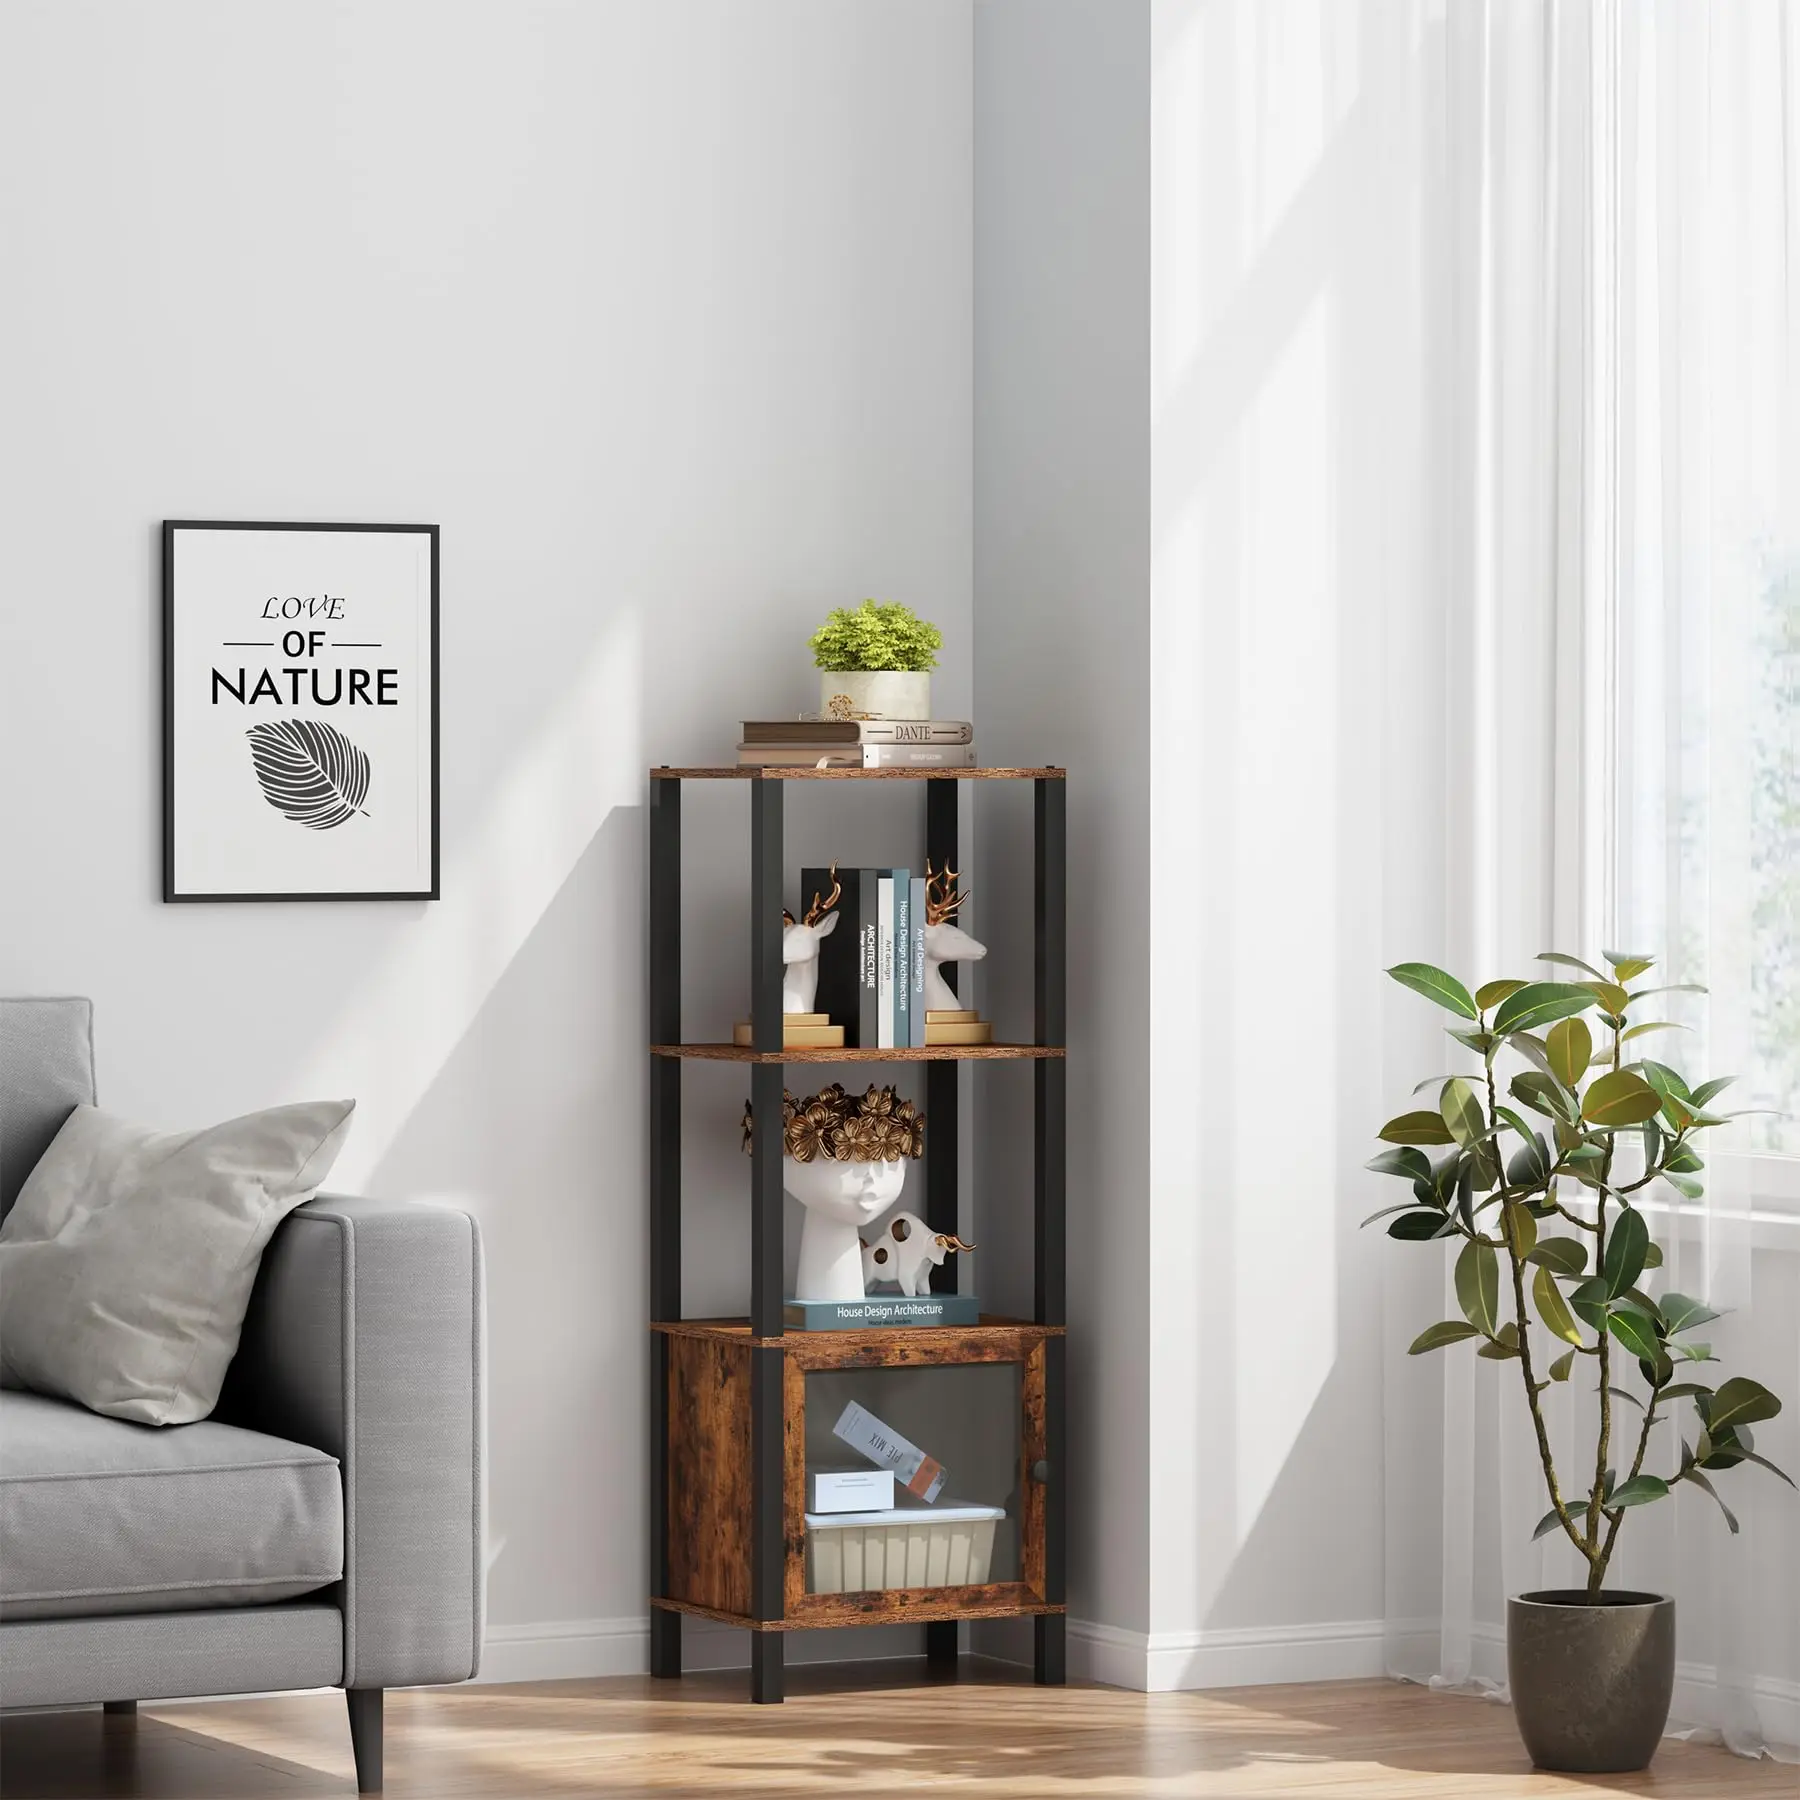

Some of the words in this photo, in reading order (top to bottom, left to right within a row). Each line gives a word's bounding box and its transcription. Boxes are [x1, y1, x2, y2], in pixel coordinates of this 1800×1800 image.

[260, 594, 345, 619] LOVE
[282, 630, 326, 657] OF
[211, 667, 398, 706] NATURE
[895, 725, 931, 740] DANTE
[900, 900, 908, 927] House
[867, 924, 875, 988] ARCHITECTURE
[898, 929, 908, 958] Design
[917, 942, 924, 951] of
[884, 953, 892, 981] design
[915, 952, 925, 993] Designing
[900, 959, 908, 1011] Architecture
[837, 1306, 863, 1318] House
[864, 1305, 893, 1319] Design
[894, 1304, 943, 1315] Architecture
[868, 1432, 887, 1452] MIX
[886, 1445, 904, 1463] PIE
